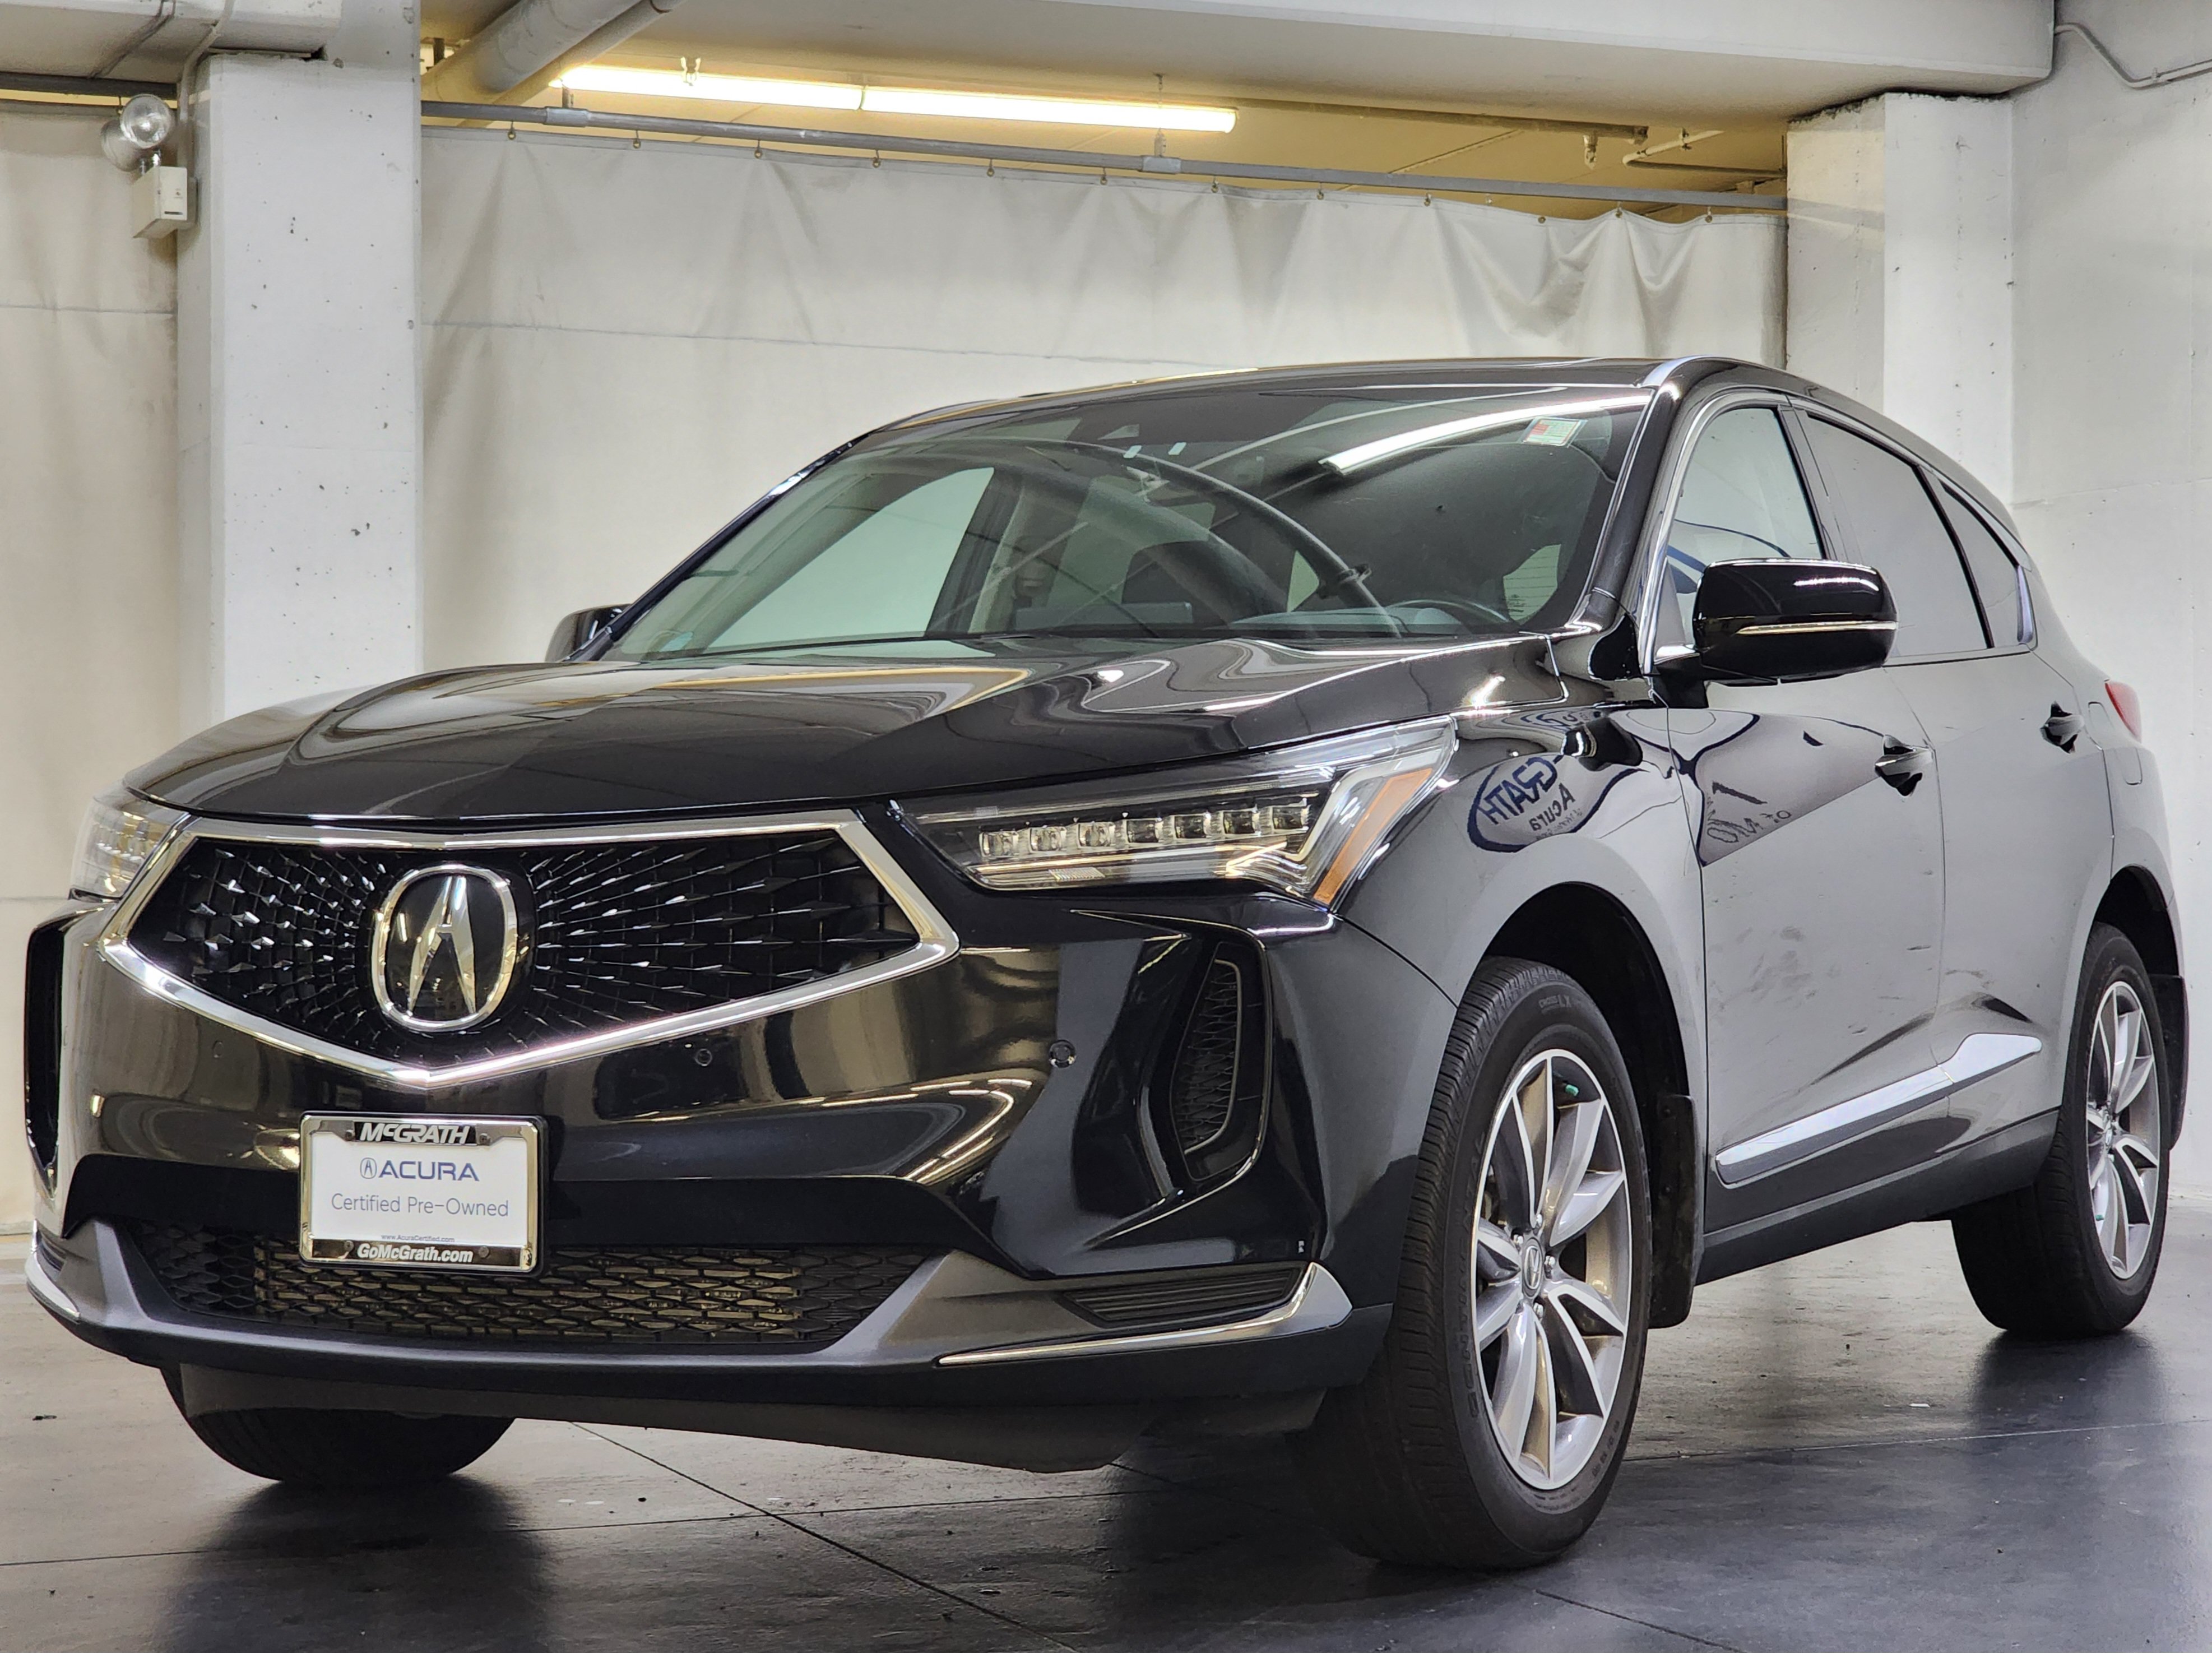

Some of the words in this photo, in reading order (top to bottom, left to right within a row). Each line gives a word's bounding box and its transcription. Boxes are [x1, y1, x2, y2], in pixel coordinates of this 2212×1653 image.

[378, 1160, 480, 1182] ACURA
[331, 1193, 400, 1212] Certified
[407, 1196, 509, 1216] Pre-Owned
[381, 1234, 455, 1243] www.AcuraCertified.com
[357, 1243, 474, 1262] GoMcGrath.com
